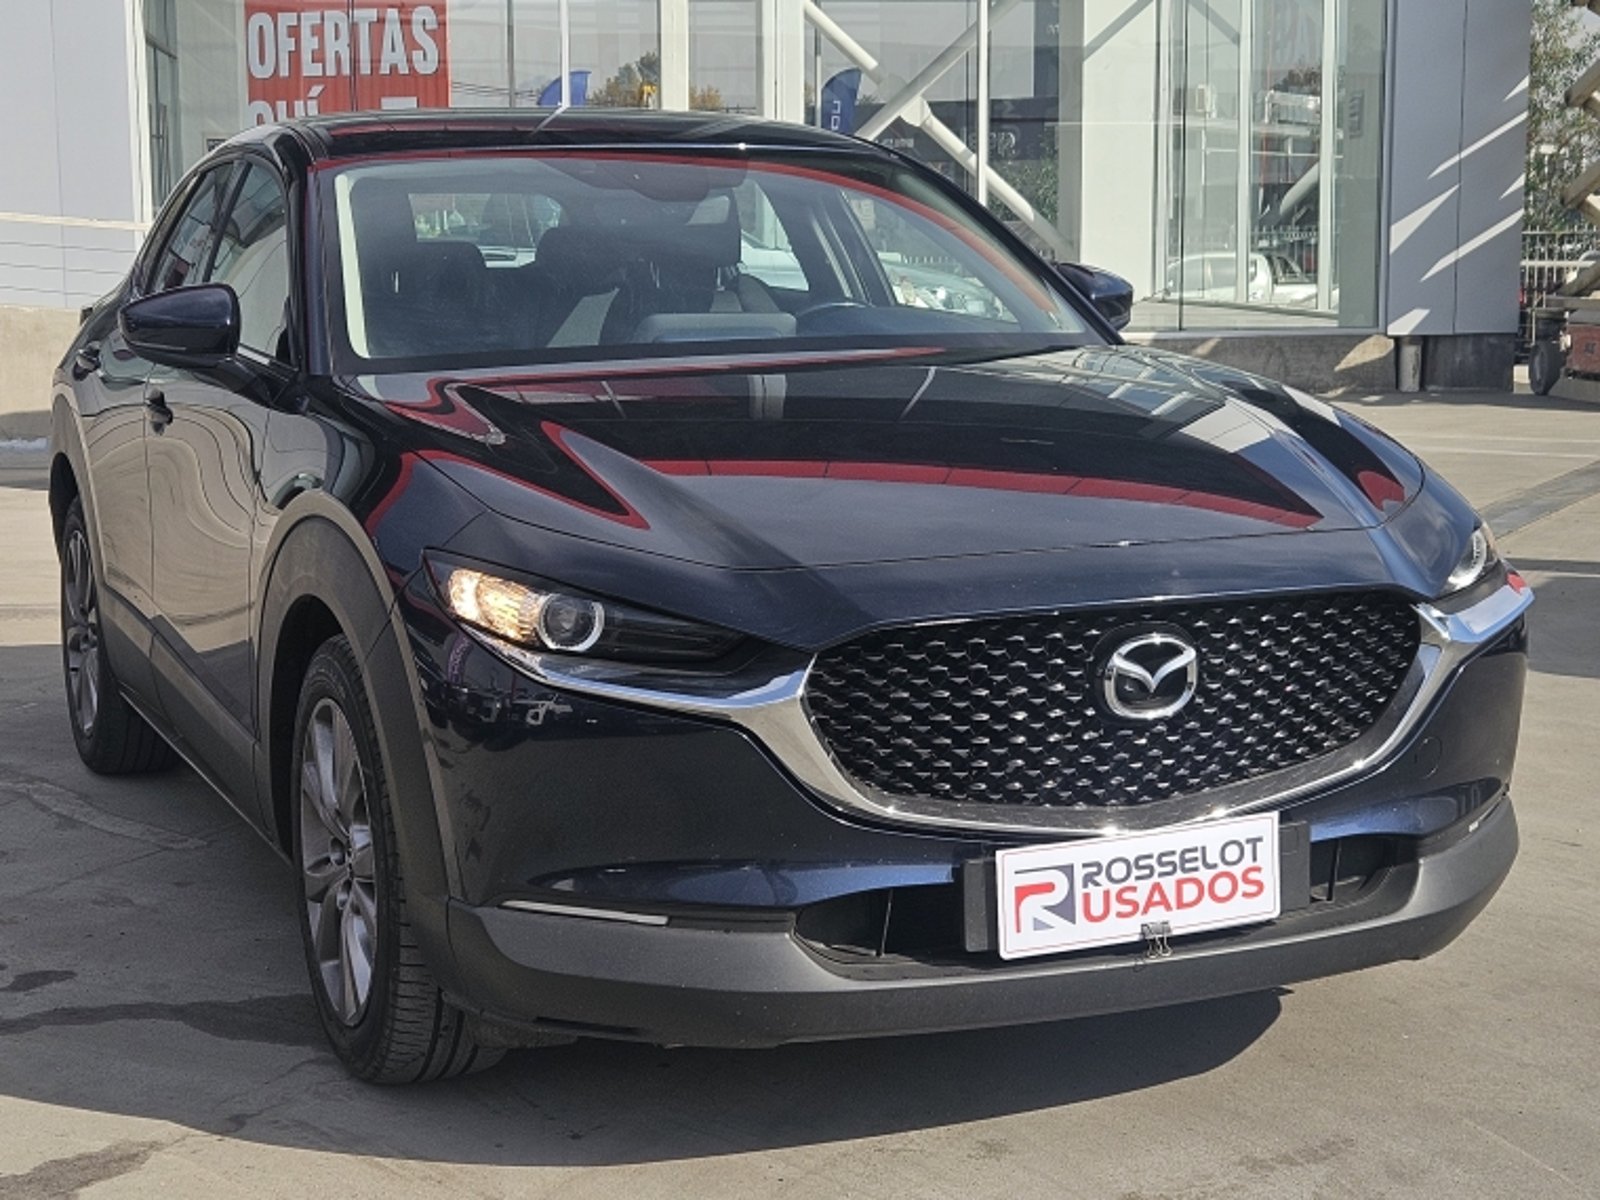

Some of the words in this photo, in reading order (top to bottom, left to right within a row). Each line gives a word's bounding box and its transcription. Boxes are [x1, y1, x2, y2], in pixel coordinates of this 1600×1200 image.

[248, 5, 439, 79] OFERTAS
[1082, 837, 1263, 889] ROSSELOT
[1082, 866, 1265, 923] USADOS
